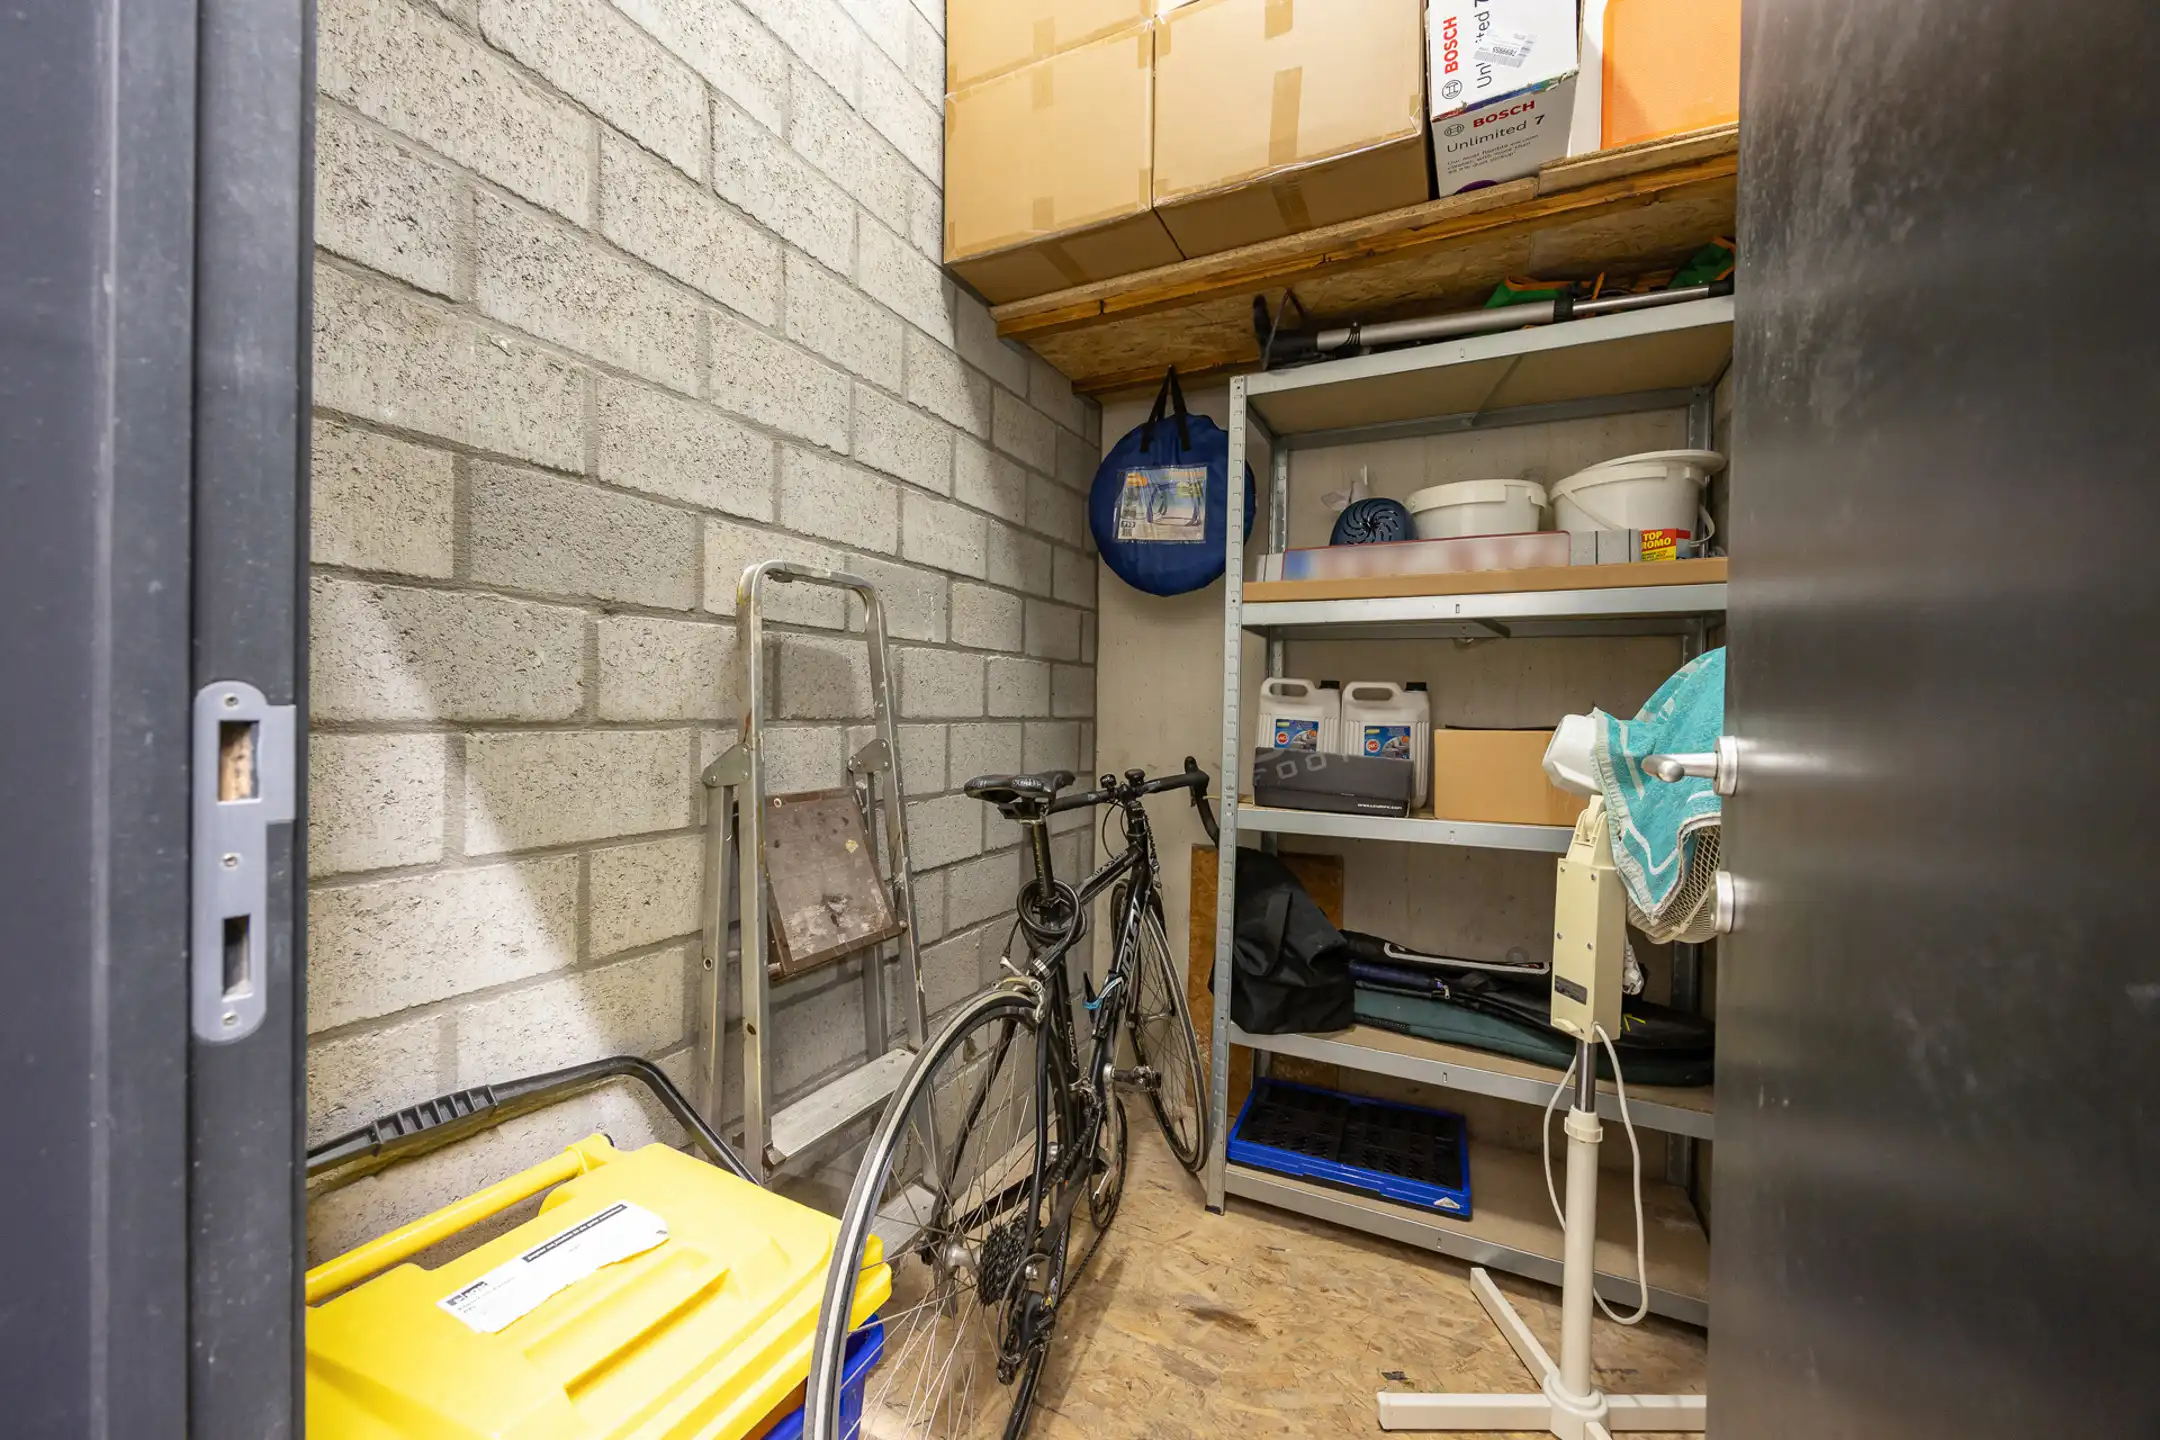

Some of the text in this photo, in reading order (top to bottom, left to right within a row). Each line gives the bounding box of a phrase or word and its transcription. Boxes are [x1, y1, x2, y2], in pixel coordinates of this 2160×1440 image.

[1444, 16, 1459, 74] BOSCH
[1473, 100, 1535, 128] BOSCH
[1447, 114, 1545, 153] Unlimited 7
[1643, 530, 1663, 541] TOP
